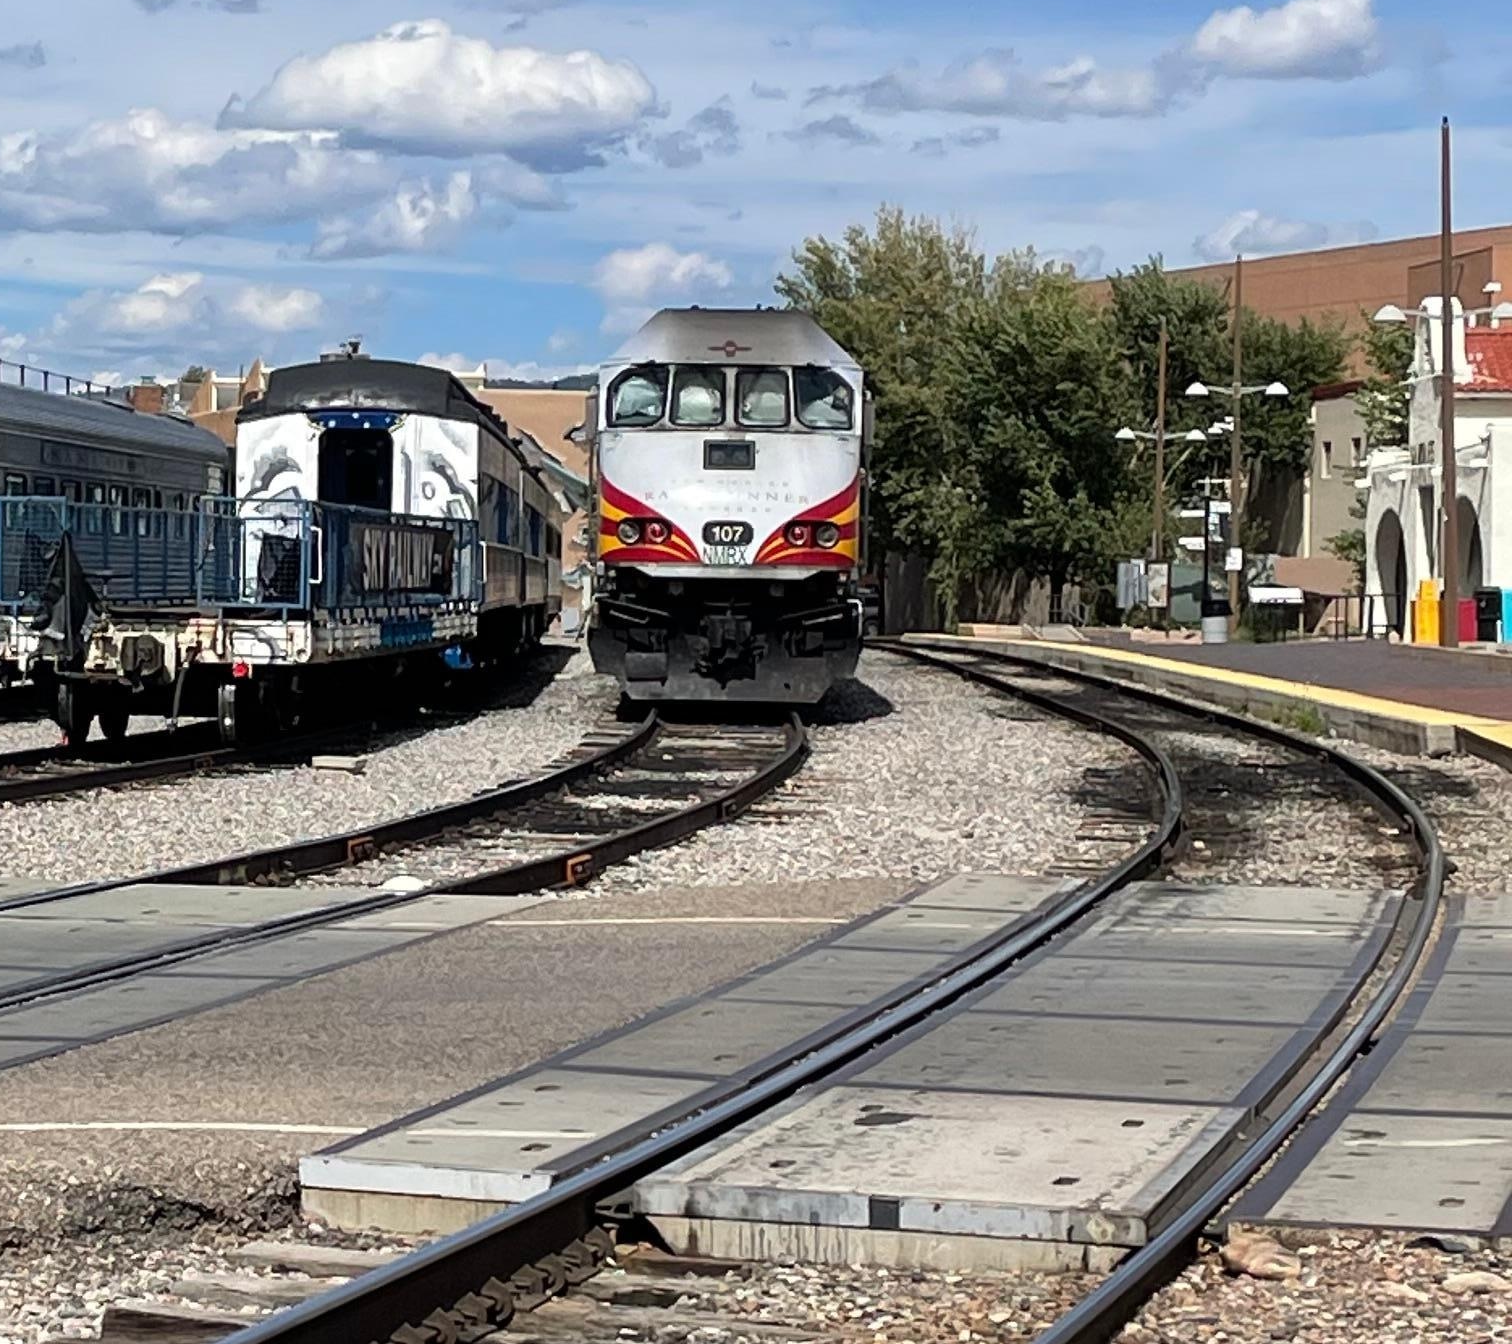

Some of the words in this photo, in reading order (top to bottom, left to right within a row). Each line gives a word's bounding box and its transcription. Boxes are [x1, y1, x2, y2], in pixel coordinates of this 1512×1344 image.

[711, 525, 744, 542] 107
[363, 526, 387, 591] SKY
[389, 529, 434, 589] RAILWAY
[702, 545, 747, 566] NMRX
